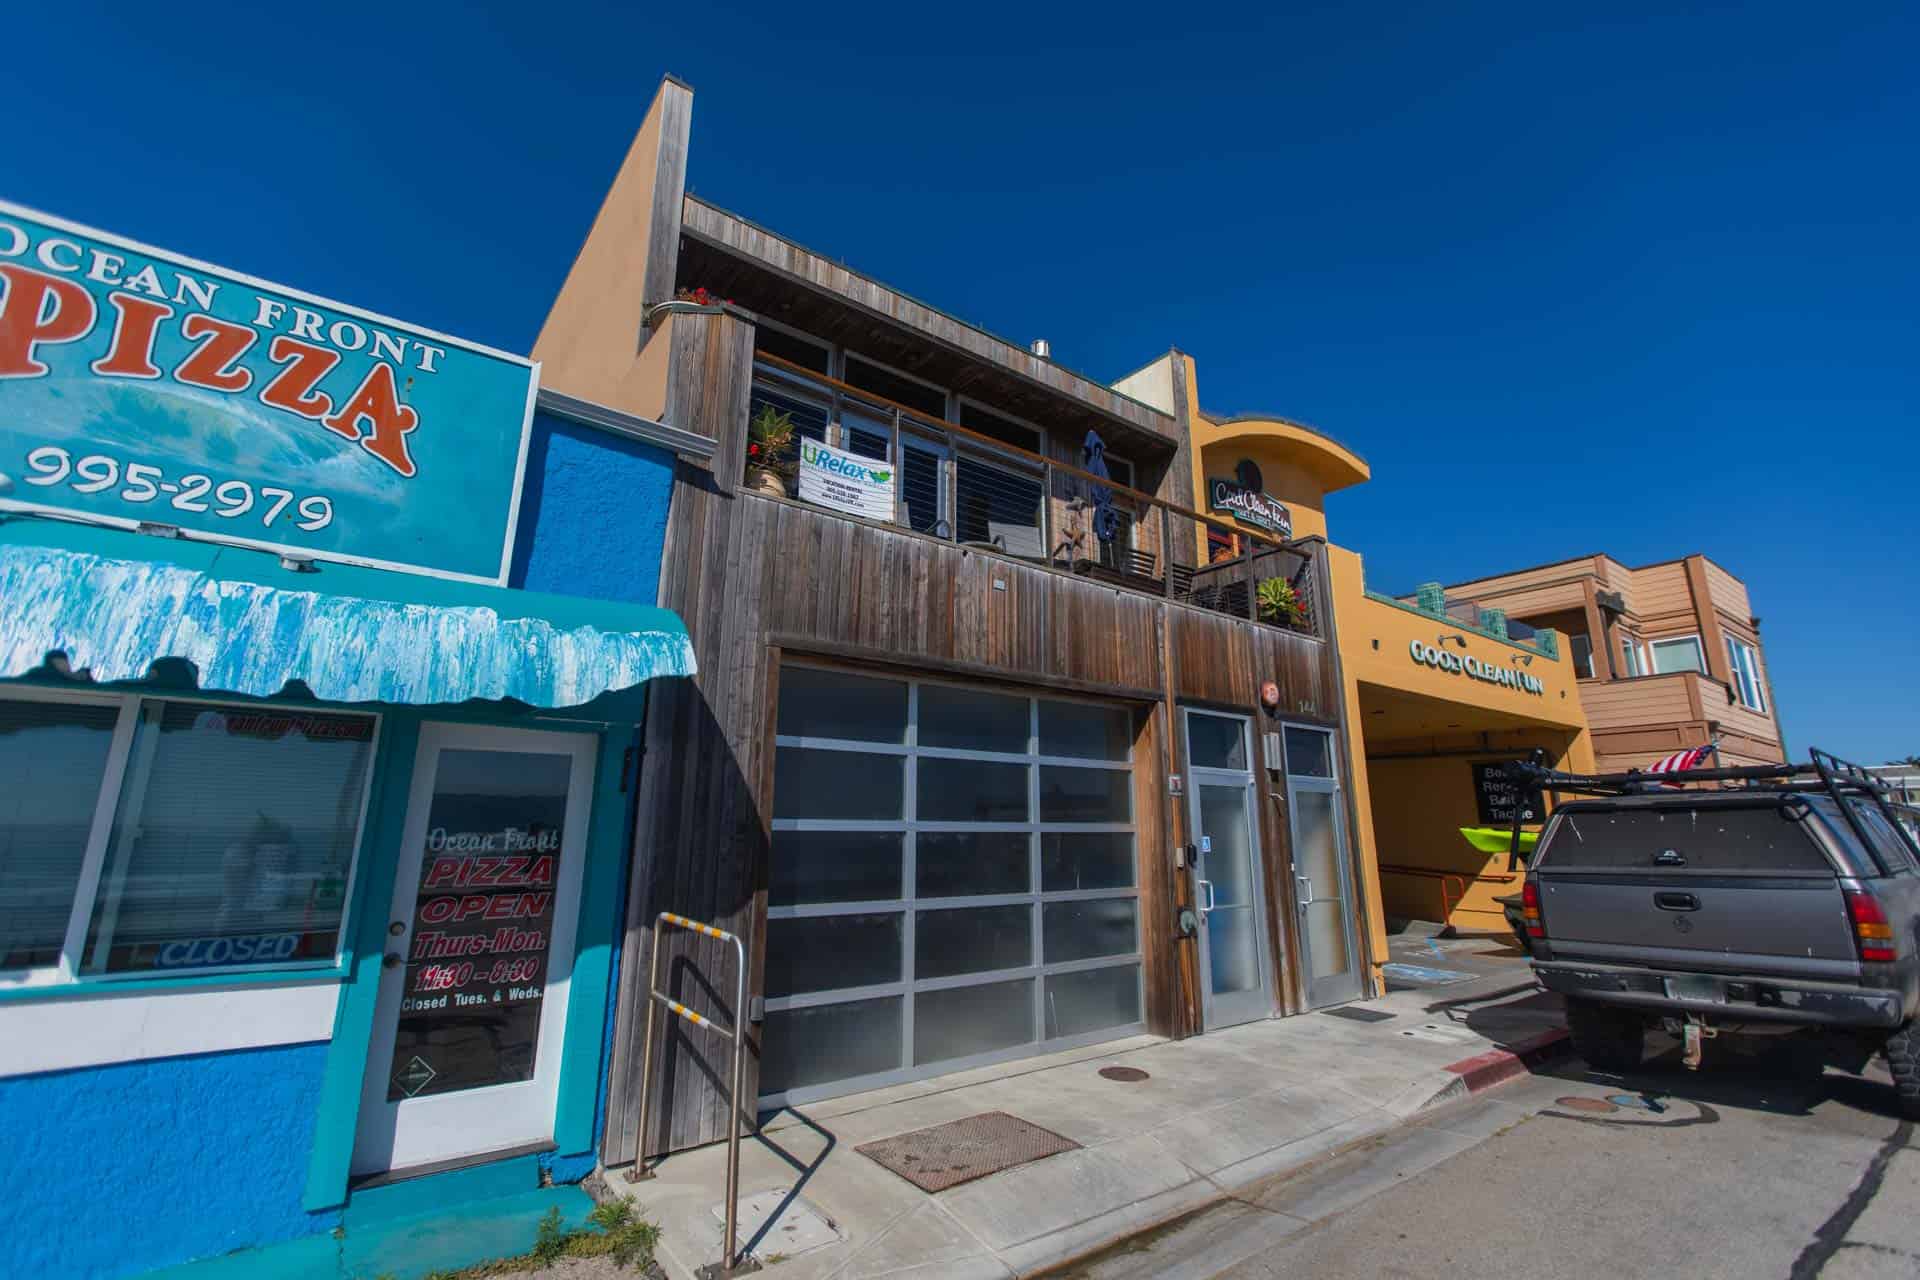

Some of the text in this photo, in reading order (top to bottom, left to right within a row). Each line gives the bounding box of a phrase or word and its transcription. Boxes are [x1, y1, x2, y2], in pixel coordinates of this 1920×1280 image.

[0, 223, 446, 373] OCEAN FRONT
[0, 261, 419, 478] PIZZA
[803, 443, 868, 480] URelax
[24, 446, 335, 532] 995-2979
[1410, 639, 1462, 675] GOOD
[1463, 654, 1515, 689] CLEAN
[423, 855, 553, 889] PIZZA
[420, 891, 551, 924] OPEN
[160, 934, 299, 966] CLOSED
[402, 994, 448, 1012] Closed
[454, 991, 488, 1007] Tues.
[508, 986, 544, 1002] Weds.
